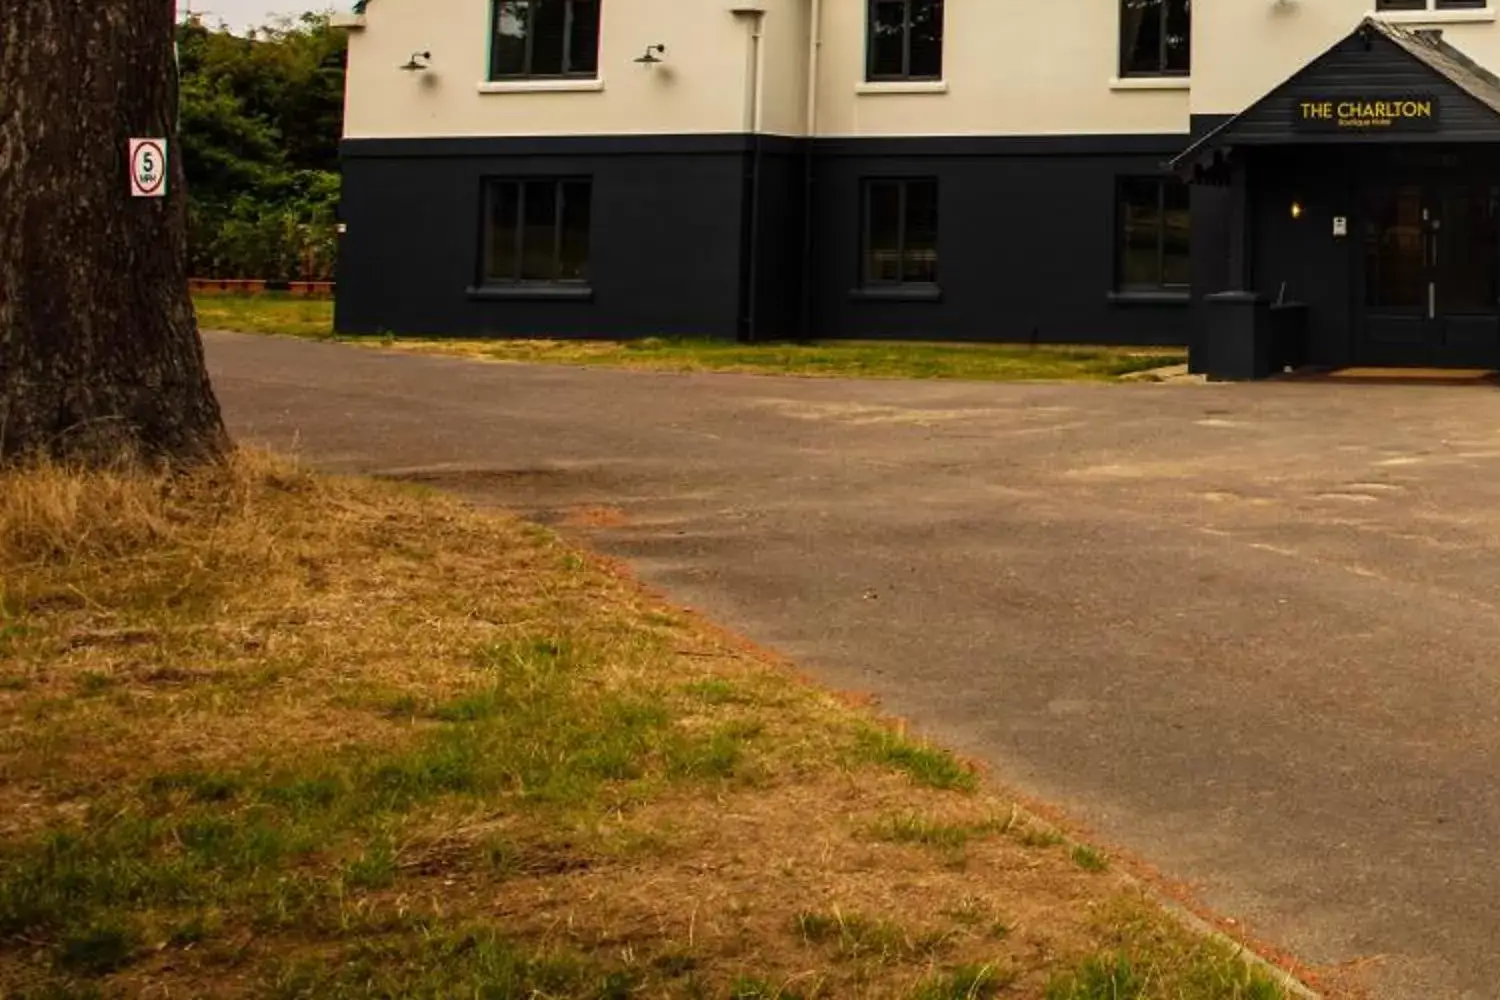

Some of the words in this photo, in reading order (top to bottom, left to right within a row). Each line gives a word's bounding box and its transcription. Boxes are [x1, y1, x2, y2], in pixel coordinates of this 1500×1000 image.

[1300, 102, 1333, 119] THE
[1337, 101, 1432, 117] CHARLTON
[143, 151, 154, 173] 5
